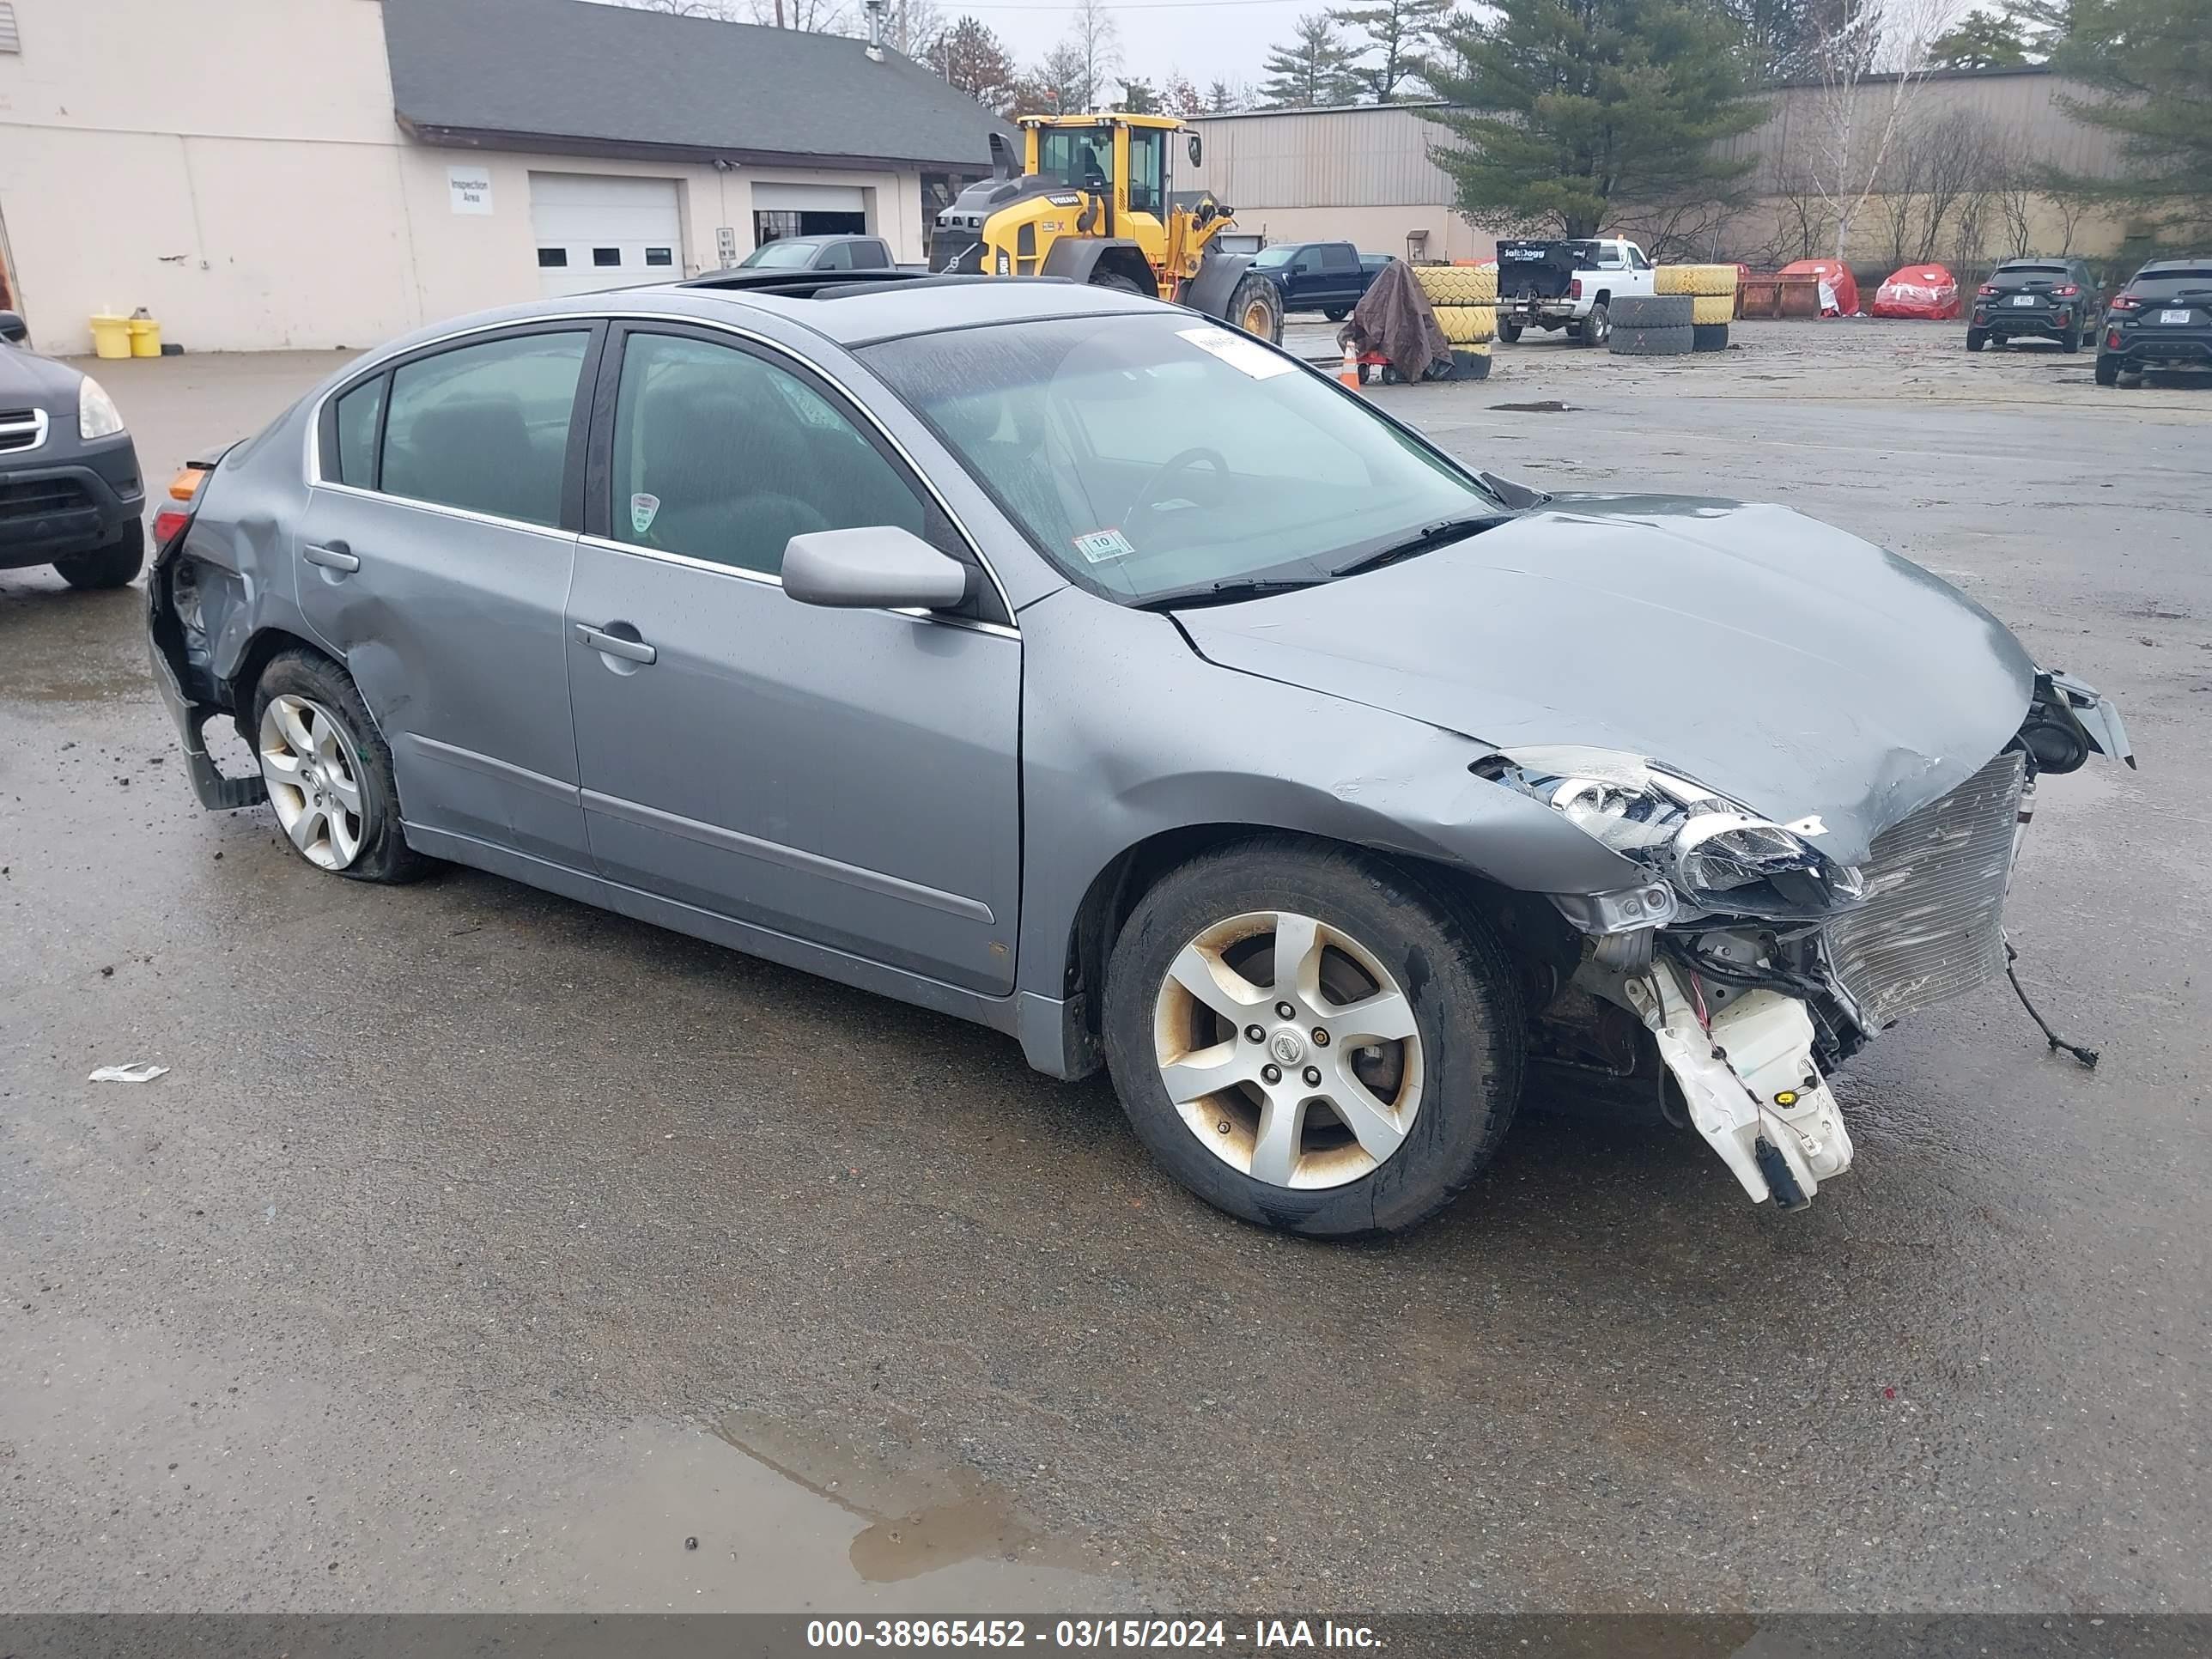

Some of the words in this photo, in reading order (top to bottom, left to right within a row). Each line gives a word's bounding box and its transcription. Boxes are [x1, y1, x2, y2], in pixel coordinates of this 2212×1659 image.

[450, 179, 489, 190] Inspection
[463, 191, 480, 203] Area
[1048, 196, 1079, 205] VOLVO
[1092, 538, 1110, 548] 10
